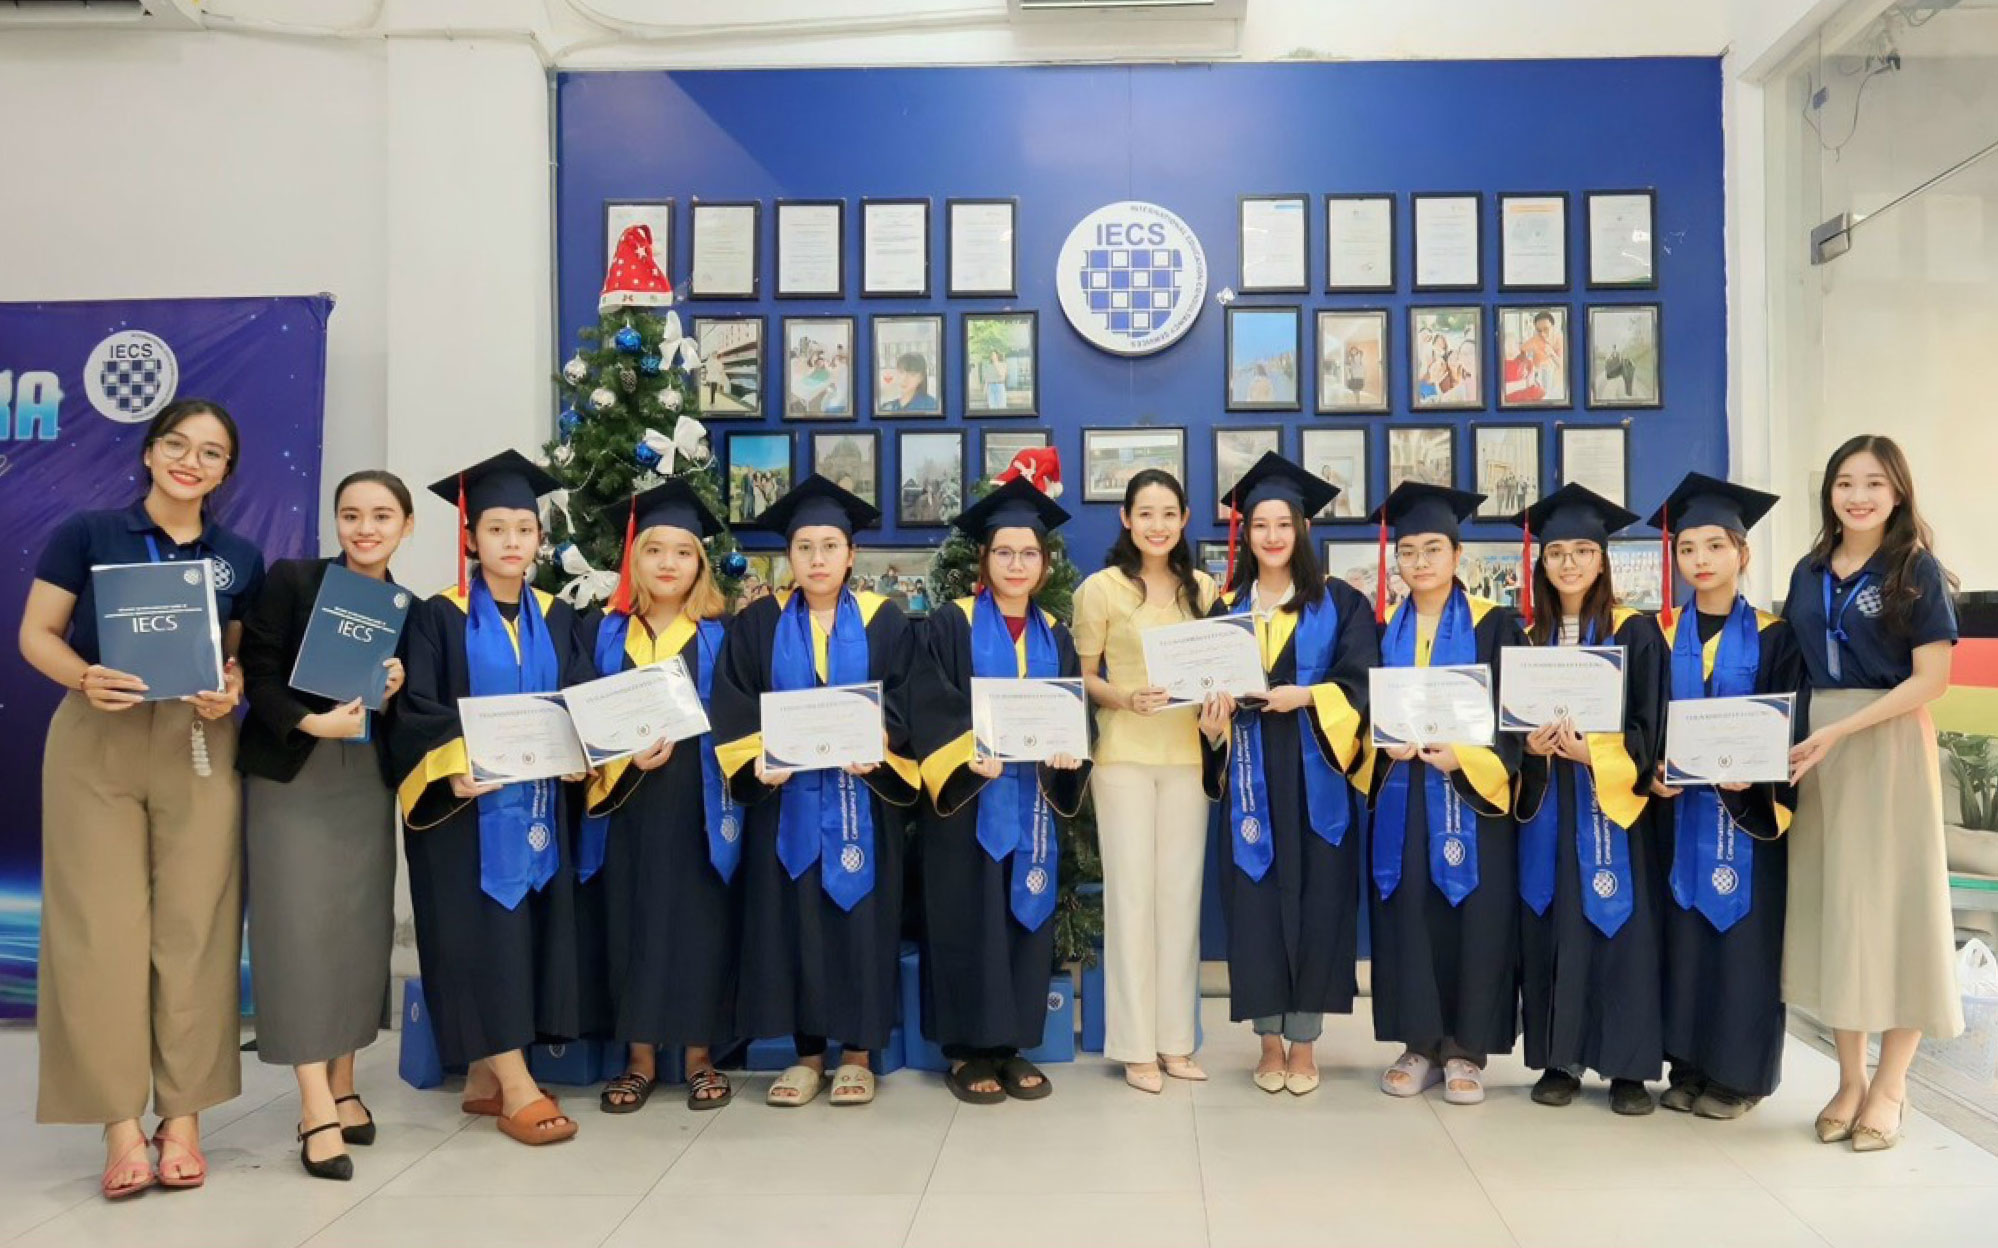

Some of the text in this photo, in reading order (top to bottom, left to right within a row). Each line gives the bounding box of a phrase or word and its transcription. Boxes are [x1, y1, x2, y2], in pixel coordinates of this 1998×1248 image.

[1097, 223, 1166, 246] IECS
[110, 343, 152, 359] IECS
[132, 614, 178, 633] IECS
[337, 618, 374, 643] IECS
